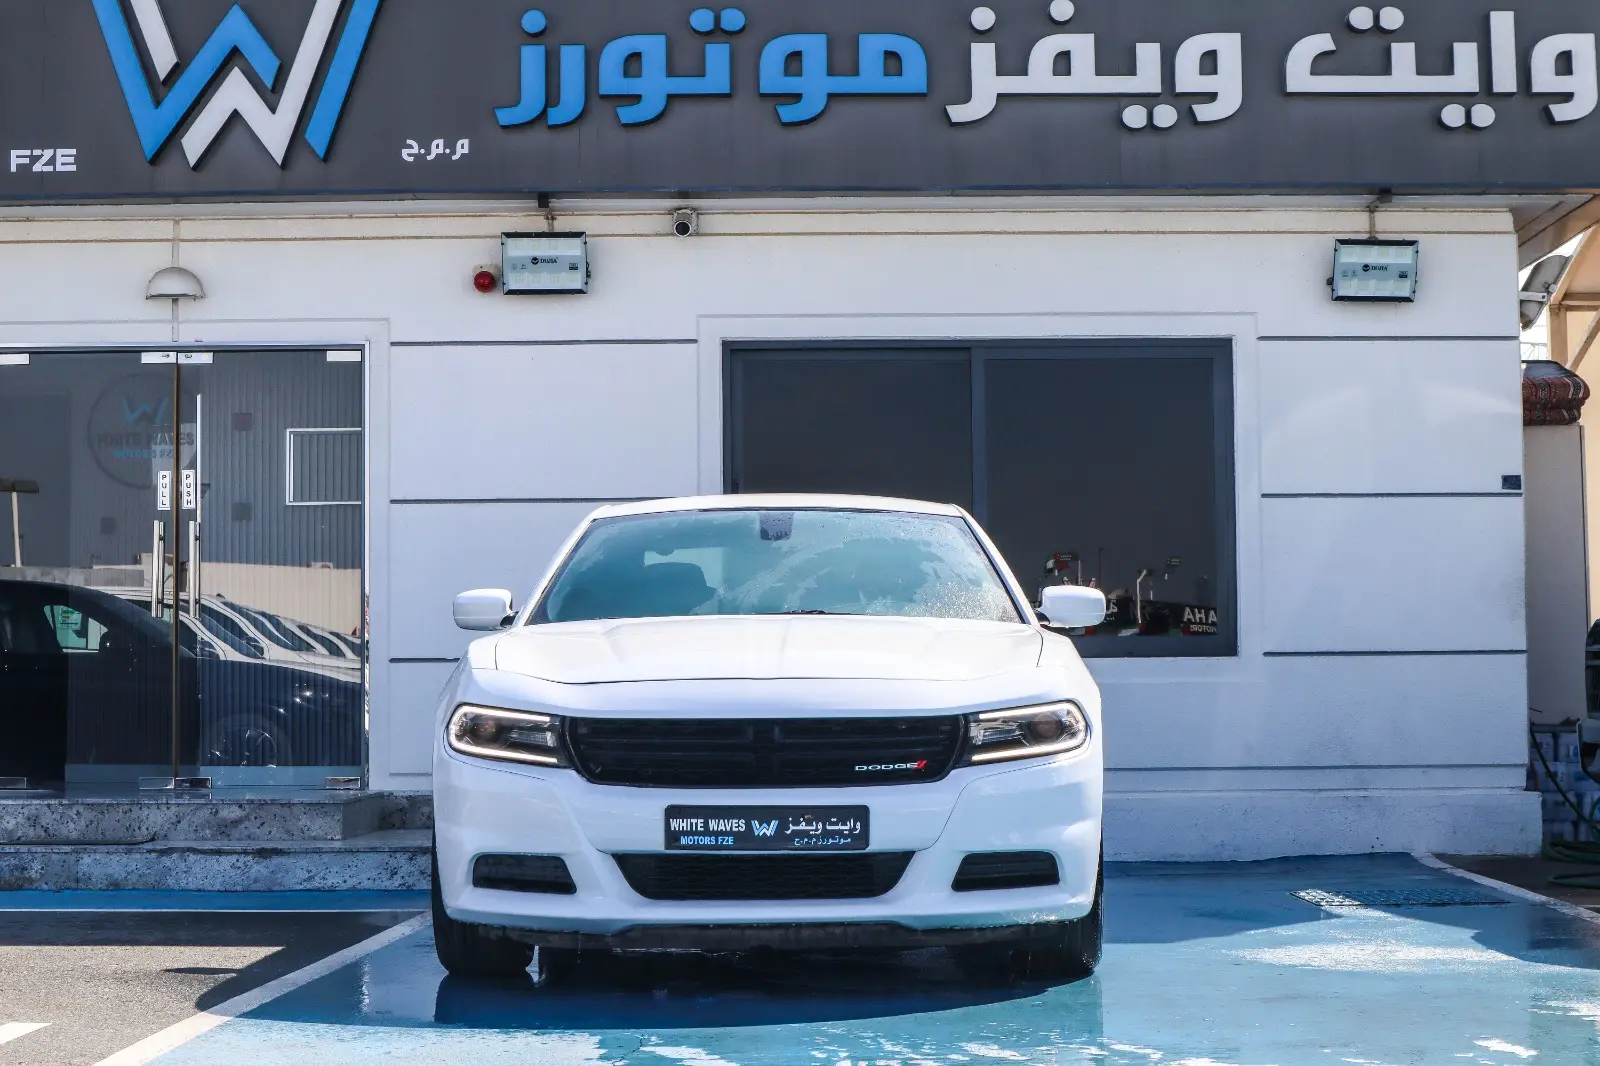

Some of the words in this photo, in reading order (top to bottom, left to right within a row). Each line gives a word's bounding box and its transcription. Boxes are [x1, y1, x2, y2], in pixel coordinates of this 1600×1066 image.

[494, 8, 928, 127] موتورز
[944, 0, 1243, 125] ويفز
[1286, 6, 1598, 127] وايت
[10, 149, 76, 172] FZE
[854, 762, 920, 771] DODGE
[669, 818, 704, 832] WHITE
[708, 818, 746, 832] WAVES
[784, 816, 823, 835] ويفز
[826, 817, 861, 834] وايت
[680, 835, 716, 845] MOTORS
[718, 836, 734, 845] FZE
